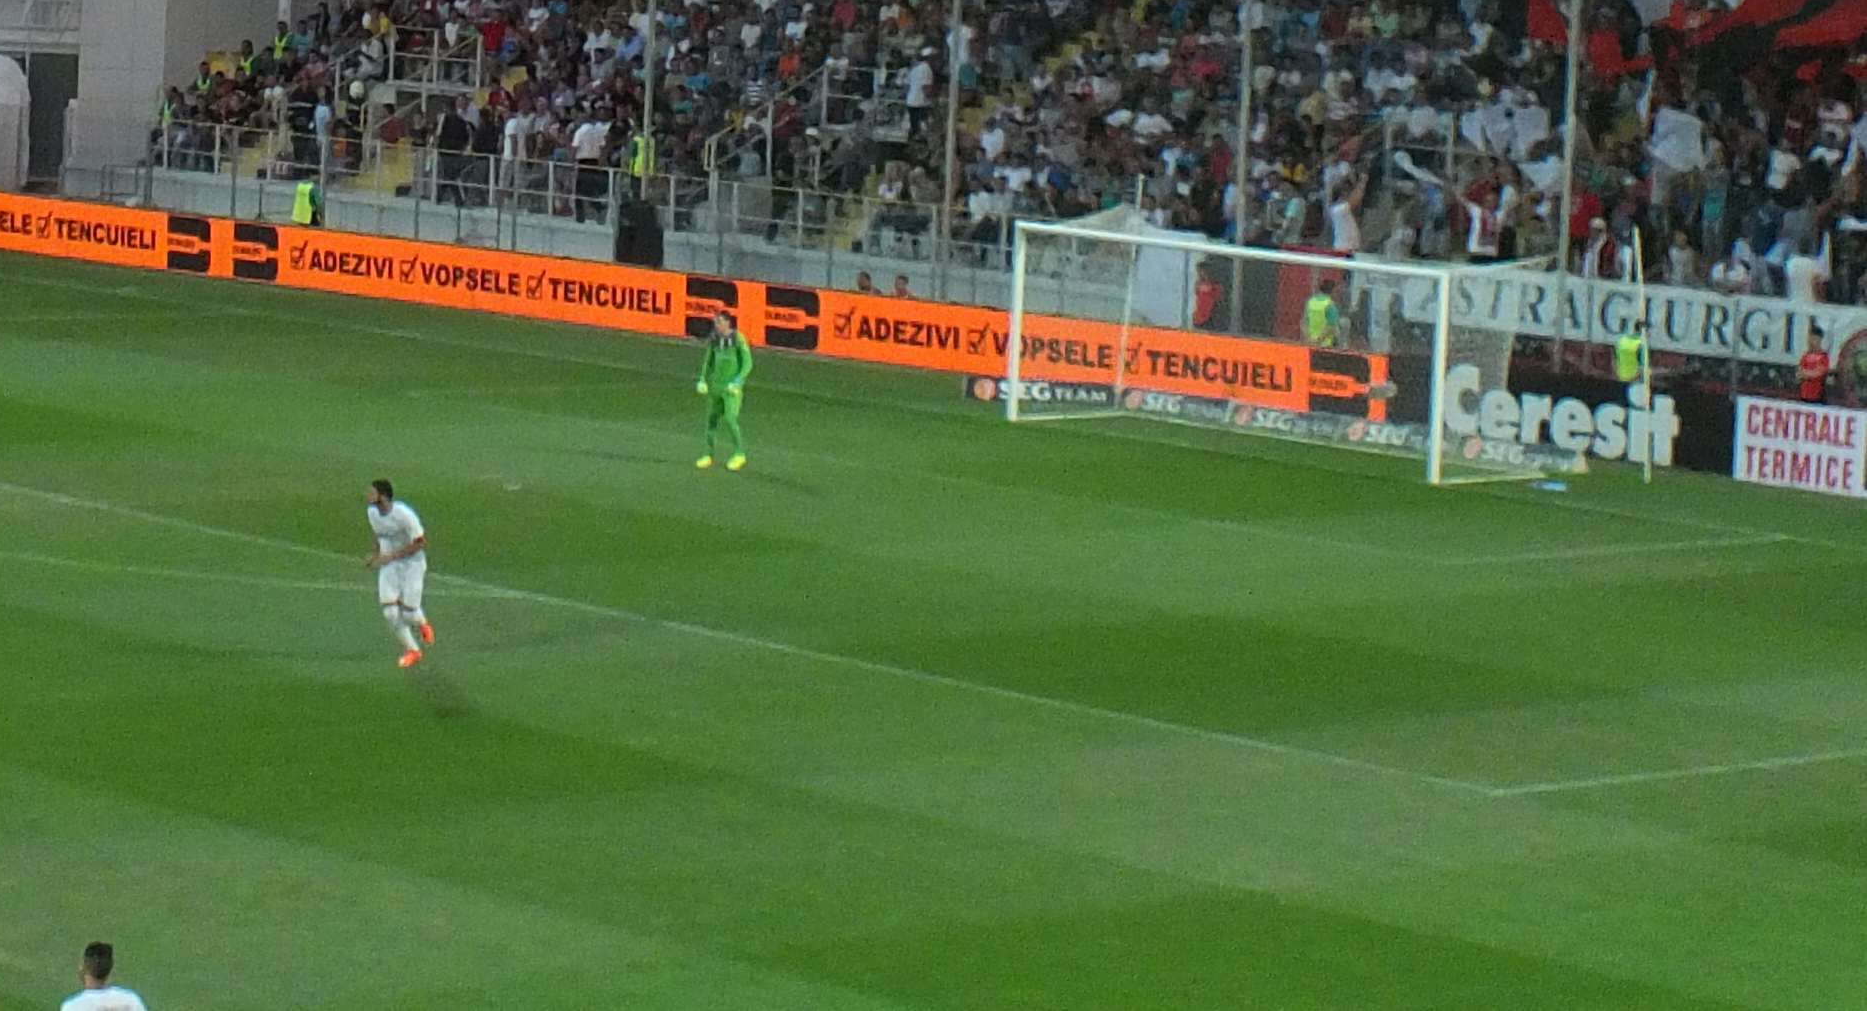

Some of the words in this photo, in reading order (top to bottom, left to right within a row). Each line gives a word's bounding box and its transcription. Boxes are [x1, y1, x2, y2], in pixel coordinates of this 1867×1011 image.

[54, 217, 157, 251] TENCUIELI
[309, 249, 394, 279] ADEZIVI
[420, 261, 521, 297] VOPSELE
[548, 277, 672, 316] TENCUIELI
[856, 315, 961, 351] ADEZIVI
[1146, 350, 1292, 392] TENCUIELI
[1443, 363, 1681, 466] Ceresit
[1747, 404, 1856, 450] CENTRALE
[1745, 445, 1854, 490] TERMICE
